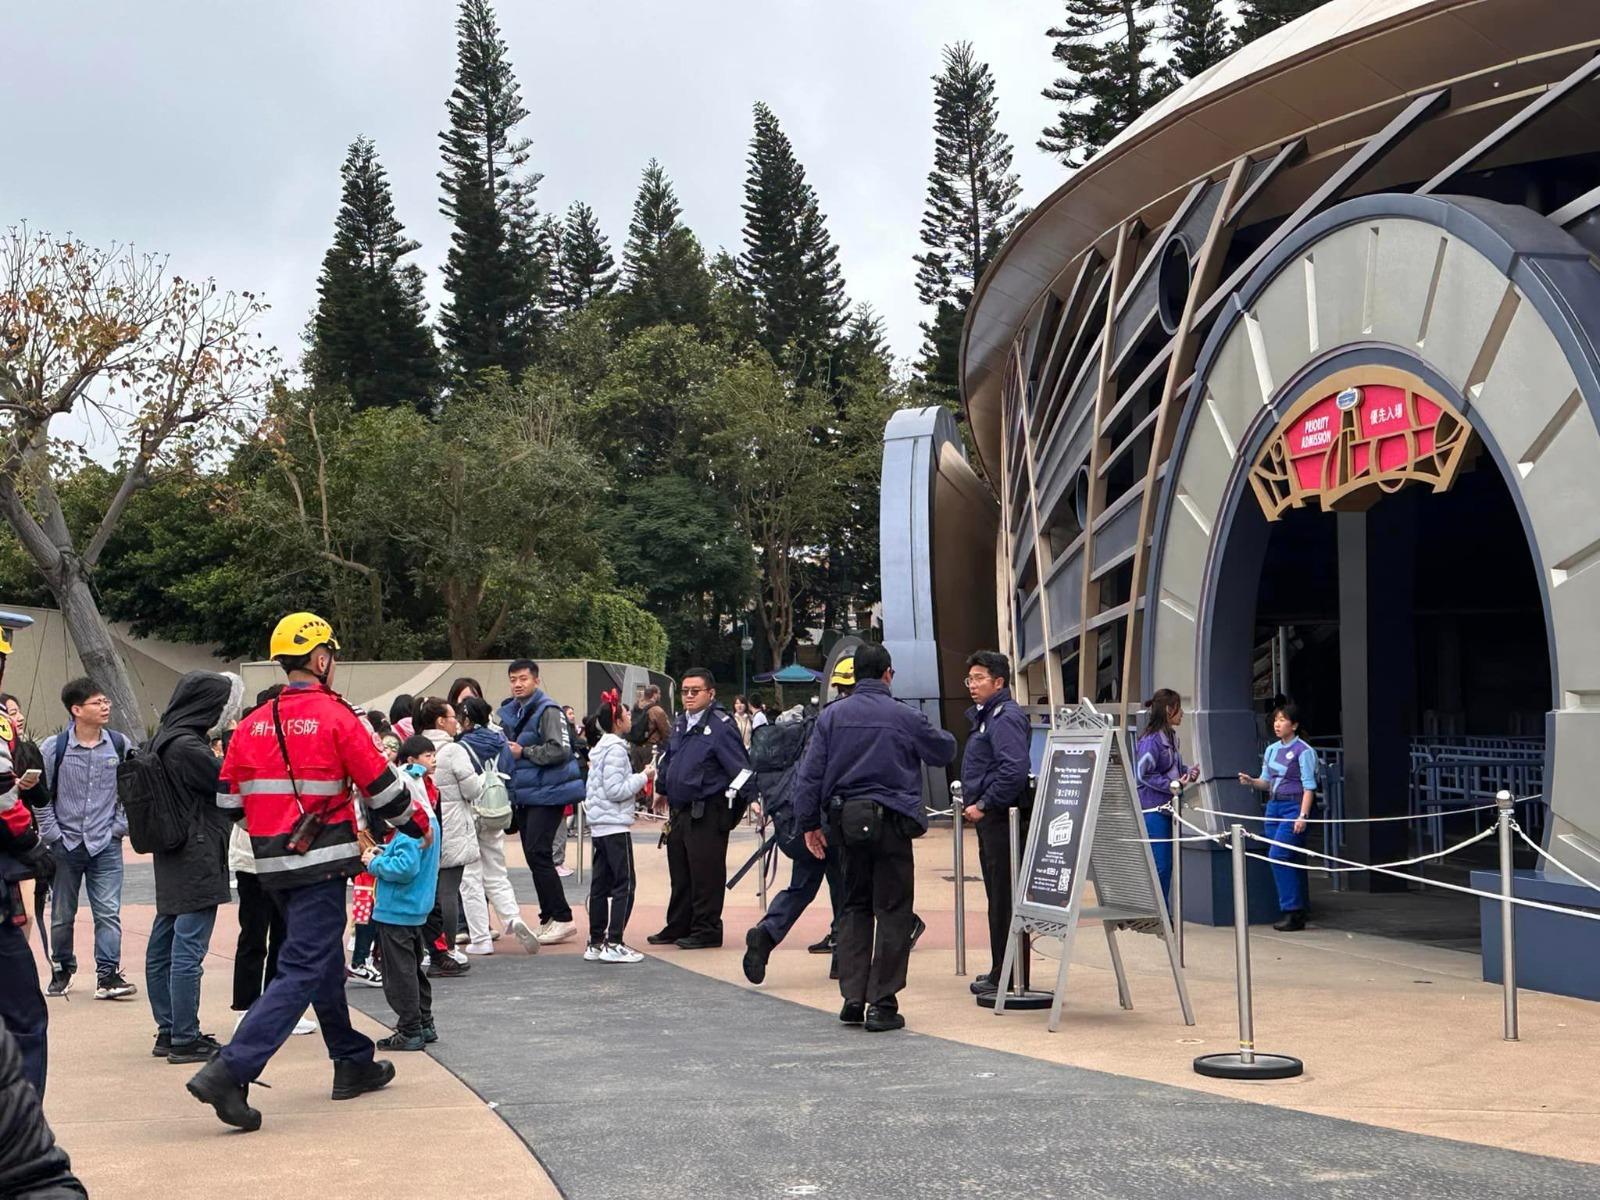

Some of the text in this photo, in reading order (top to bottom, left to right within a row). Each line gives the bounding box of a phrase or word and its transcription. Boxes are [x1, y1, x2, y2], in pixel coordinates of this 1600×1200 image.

[1370, 403, 1403, 425] 優先入場
[1305, 416, 1329, 434] PRIORITY
[1301, 431, 1332, 449] ADMISSION
